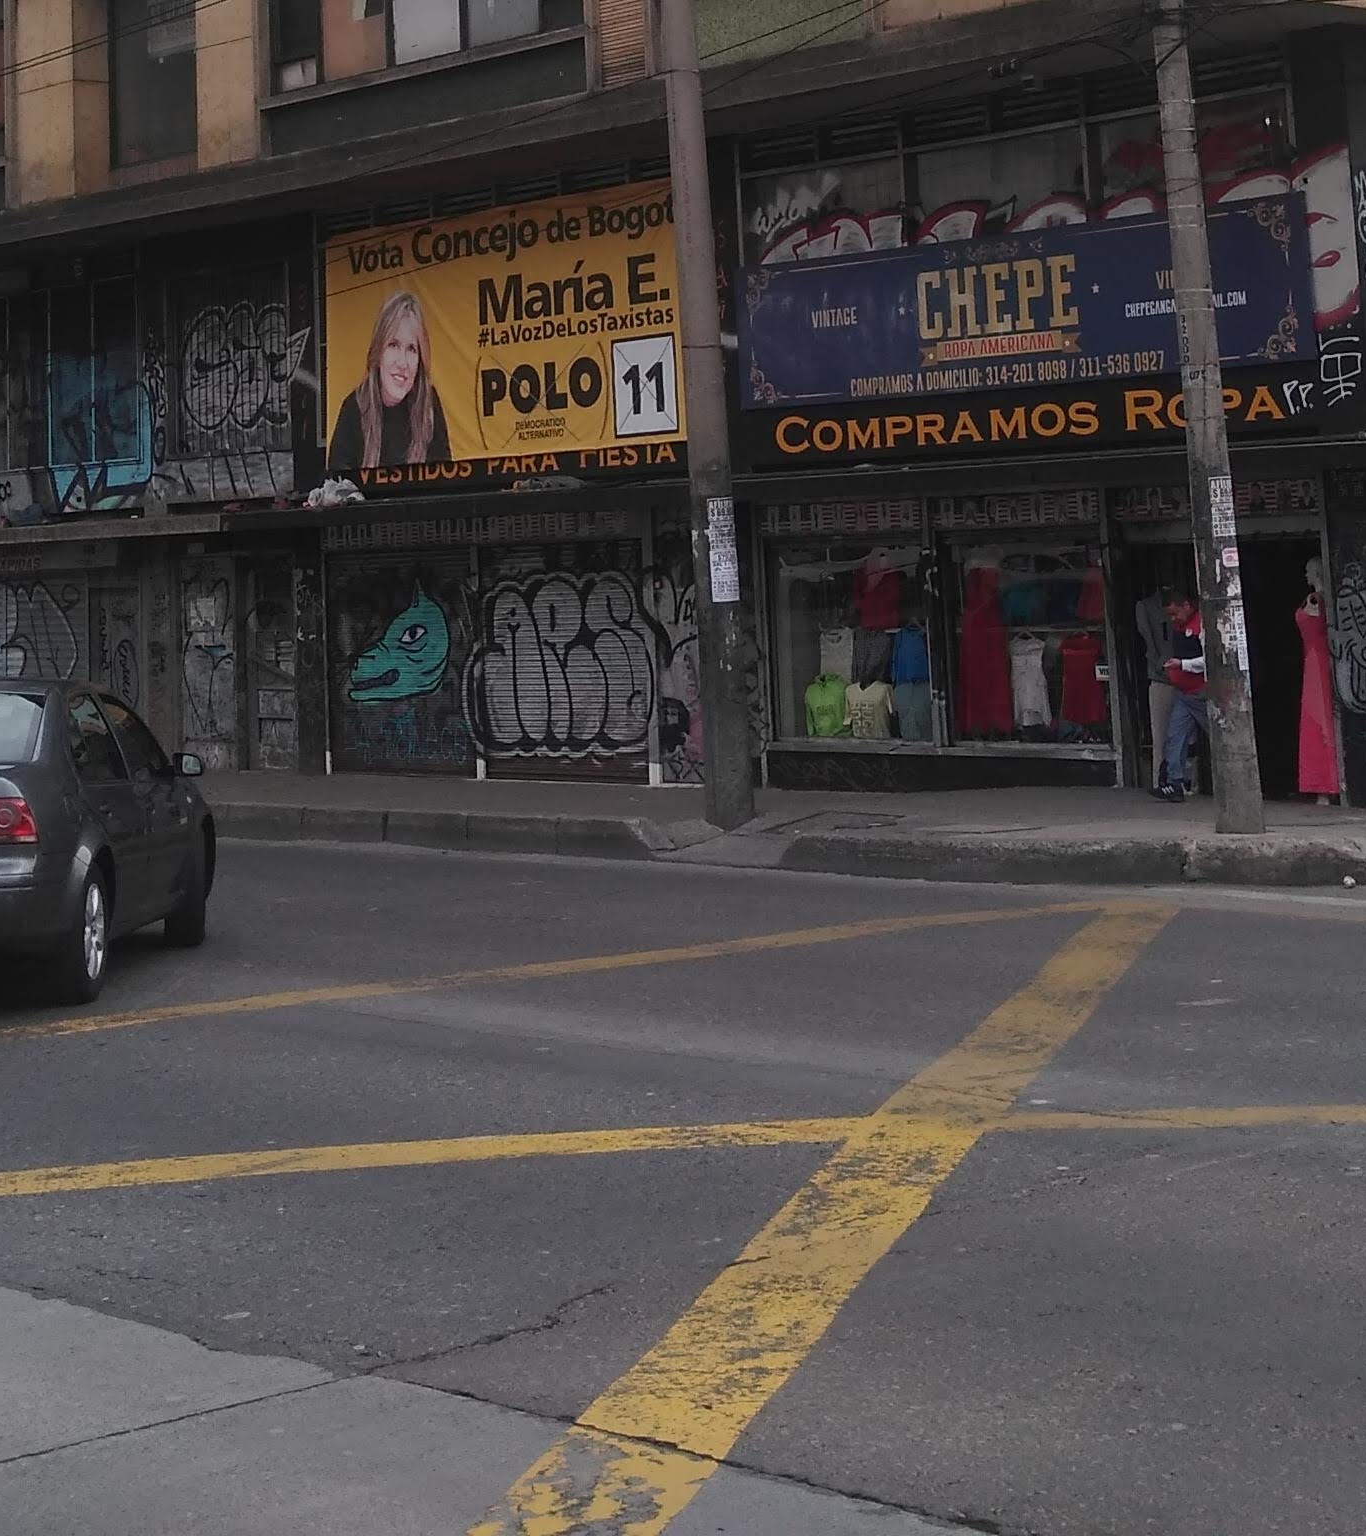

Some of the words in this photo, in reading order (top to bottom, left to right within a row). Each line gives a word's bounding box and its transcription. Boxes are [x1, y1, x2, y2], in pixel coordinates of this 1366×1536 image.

[348, 243, 403, 274] Vota
[412, 212, 538, 263] Concejo
[546, 209, 581, 244] de
[588, 199, 675, 239] Bogot
[477, 261, 614, 325] María
[627, 253, 670, 304] E.
[916, 254, 1079, 340] CHEPE
[478, 307, 674, 347] #LaVozDeLosTaxistas
[811, 306, 858, 329] VINTAGE
[945, 340, 975, 358] ROPA
[979, 333, 1055, 355] AMERICANA
[480, 356, 602, 417] POLO
[622, 362, 665, 415] 11
[850, 375, 914, 397] COMPRAMOS
[916, 372, 926, 391] A
[928, 367, 982, 391] DOMICILIO:
[985, 363, 1034, 387] 314-201
[1036, 359, 1068, 382] 8098
[1079, 353, 1131, 378] 311-536
[1134, 350, 1165, 372] 0927
[486, 452, 560, 475] PARA
